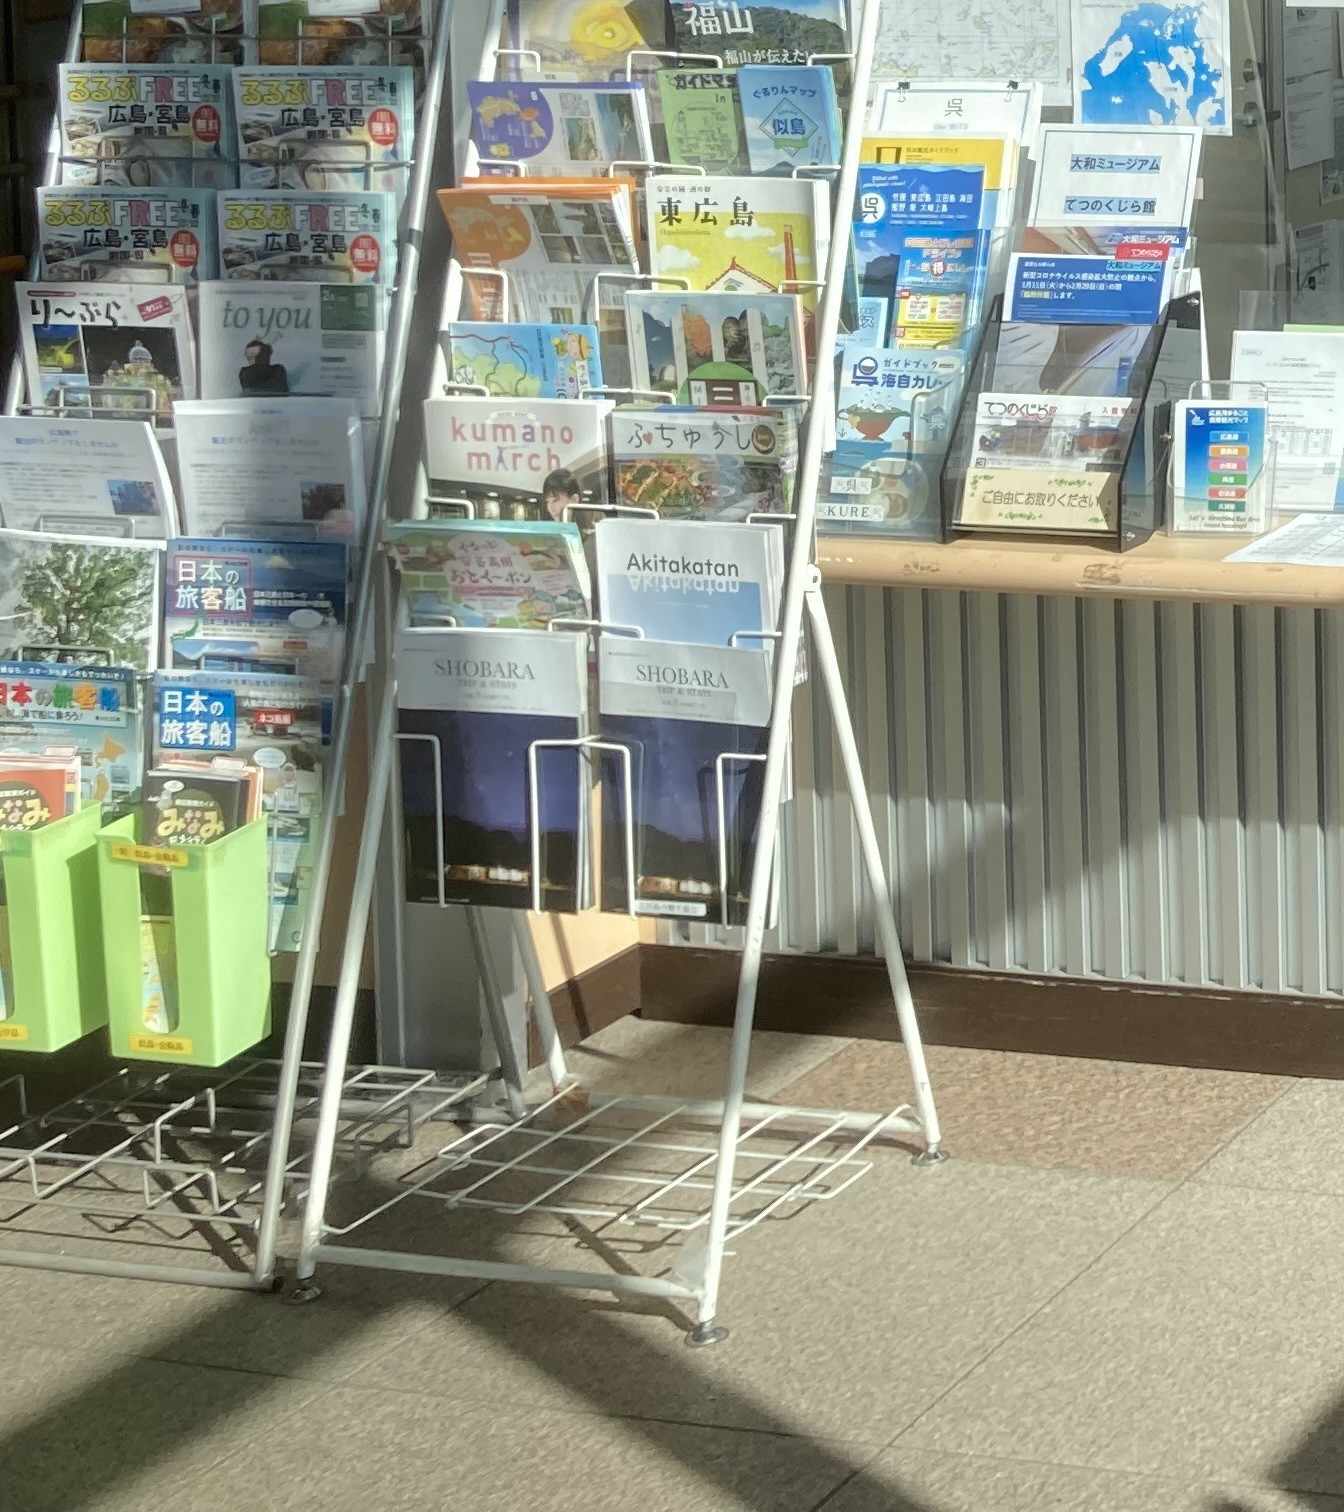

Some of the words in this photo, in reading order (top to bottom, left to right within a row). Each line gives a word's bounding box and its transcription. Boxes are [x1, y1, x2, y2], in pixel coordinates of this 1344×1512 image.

[685, 2, 754, 35] 福山
[944, 98, 964, 117] 呉
[1070, 157, 1161, 173] 大和ミュージアム
[657, 197, 755, 227] 東広島
[1065, 197, 1156, 215] てつのくじら館
[223, 300, 250, 329] to
[255, 306, 312, 338] you
[451, 417, 574, 444] kumano
[826, 504, 870, 519] KURE
[177, 560, 240, 584] 日本の
[627, 552, 740, 578] Akitakatan
[176, 586, 248, 613] 旅客船
[434, 659, 536, 682] SHOBARA
[635, 665, 730, 689] SHOBARA
[163, 690, 225, 716] 日本の
[161, 721, 232, 748] 旅客船
